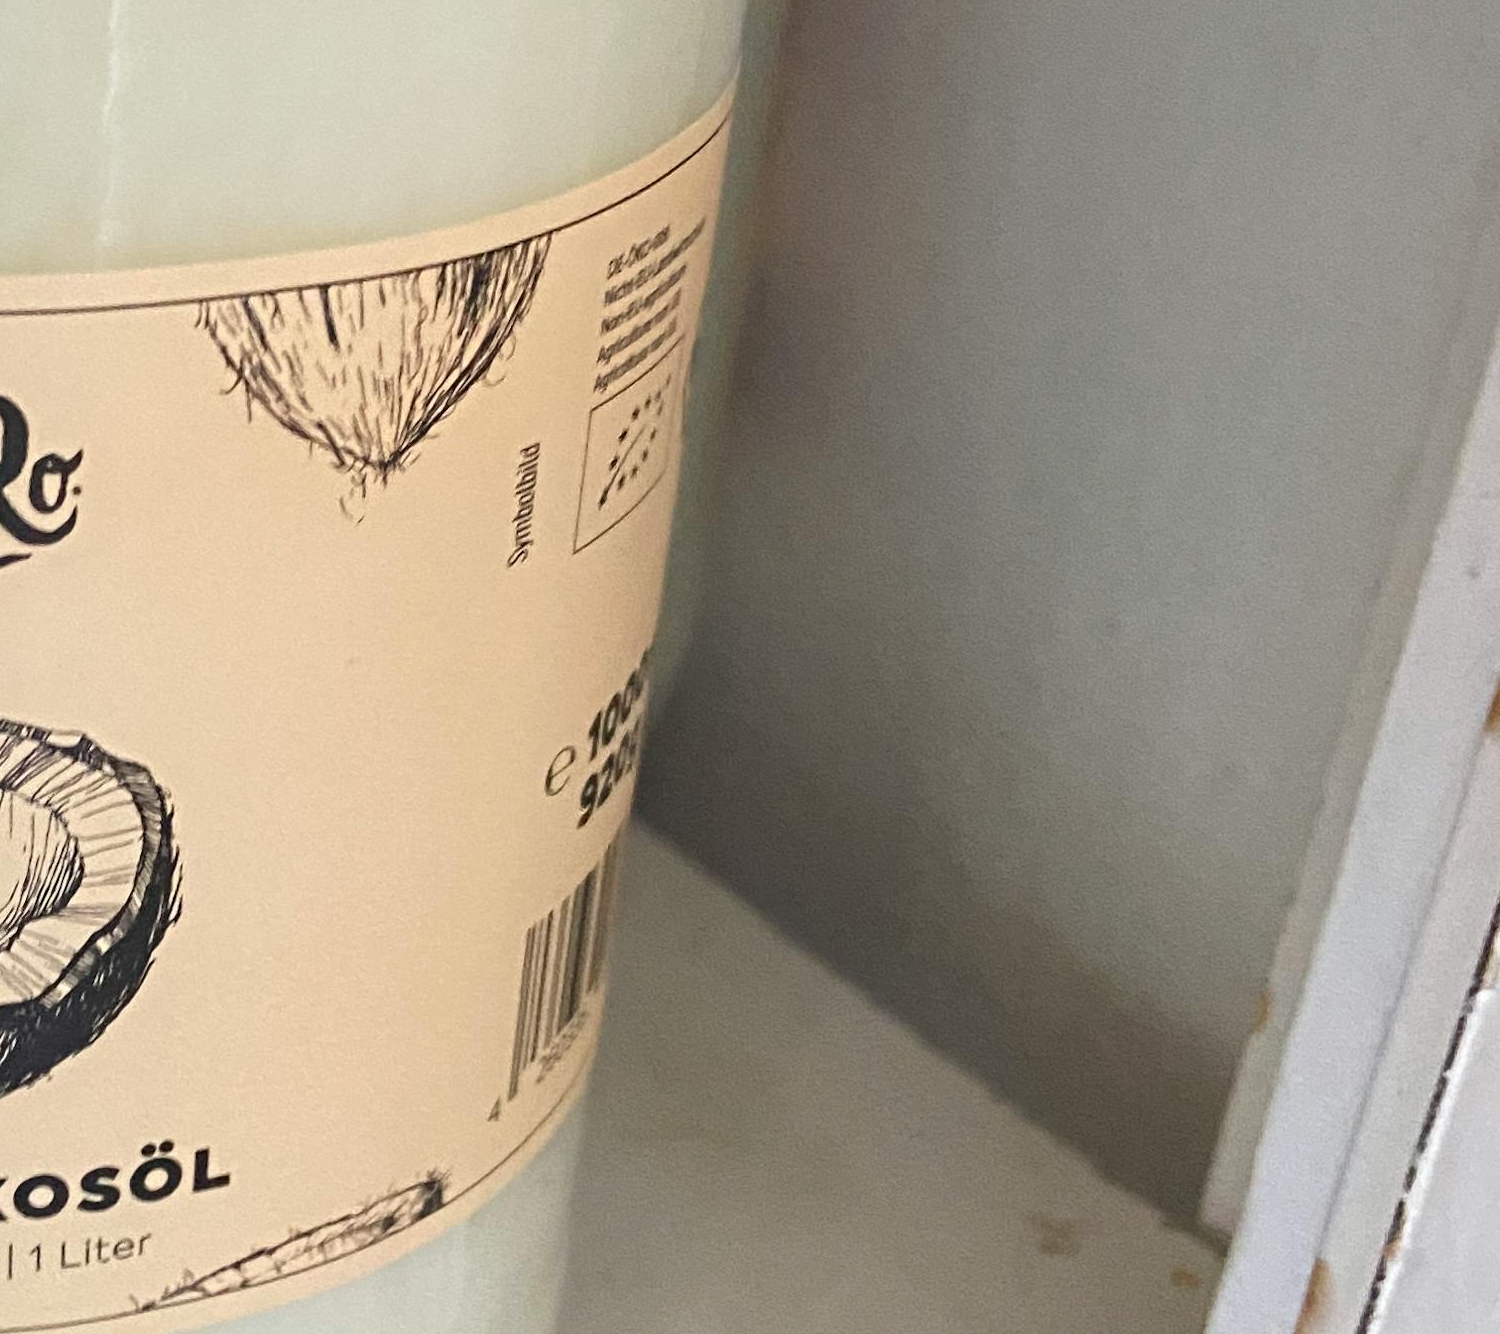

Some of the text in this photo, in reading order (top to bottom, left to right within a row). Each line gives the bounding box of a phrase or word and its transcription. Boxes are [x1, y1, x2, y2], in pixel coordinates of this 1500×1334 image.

[506, 442, 542, 569] Symbolbild
[29, 1241, 44, 1274] 1
[59, 1230, 155, 1271] Liter
